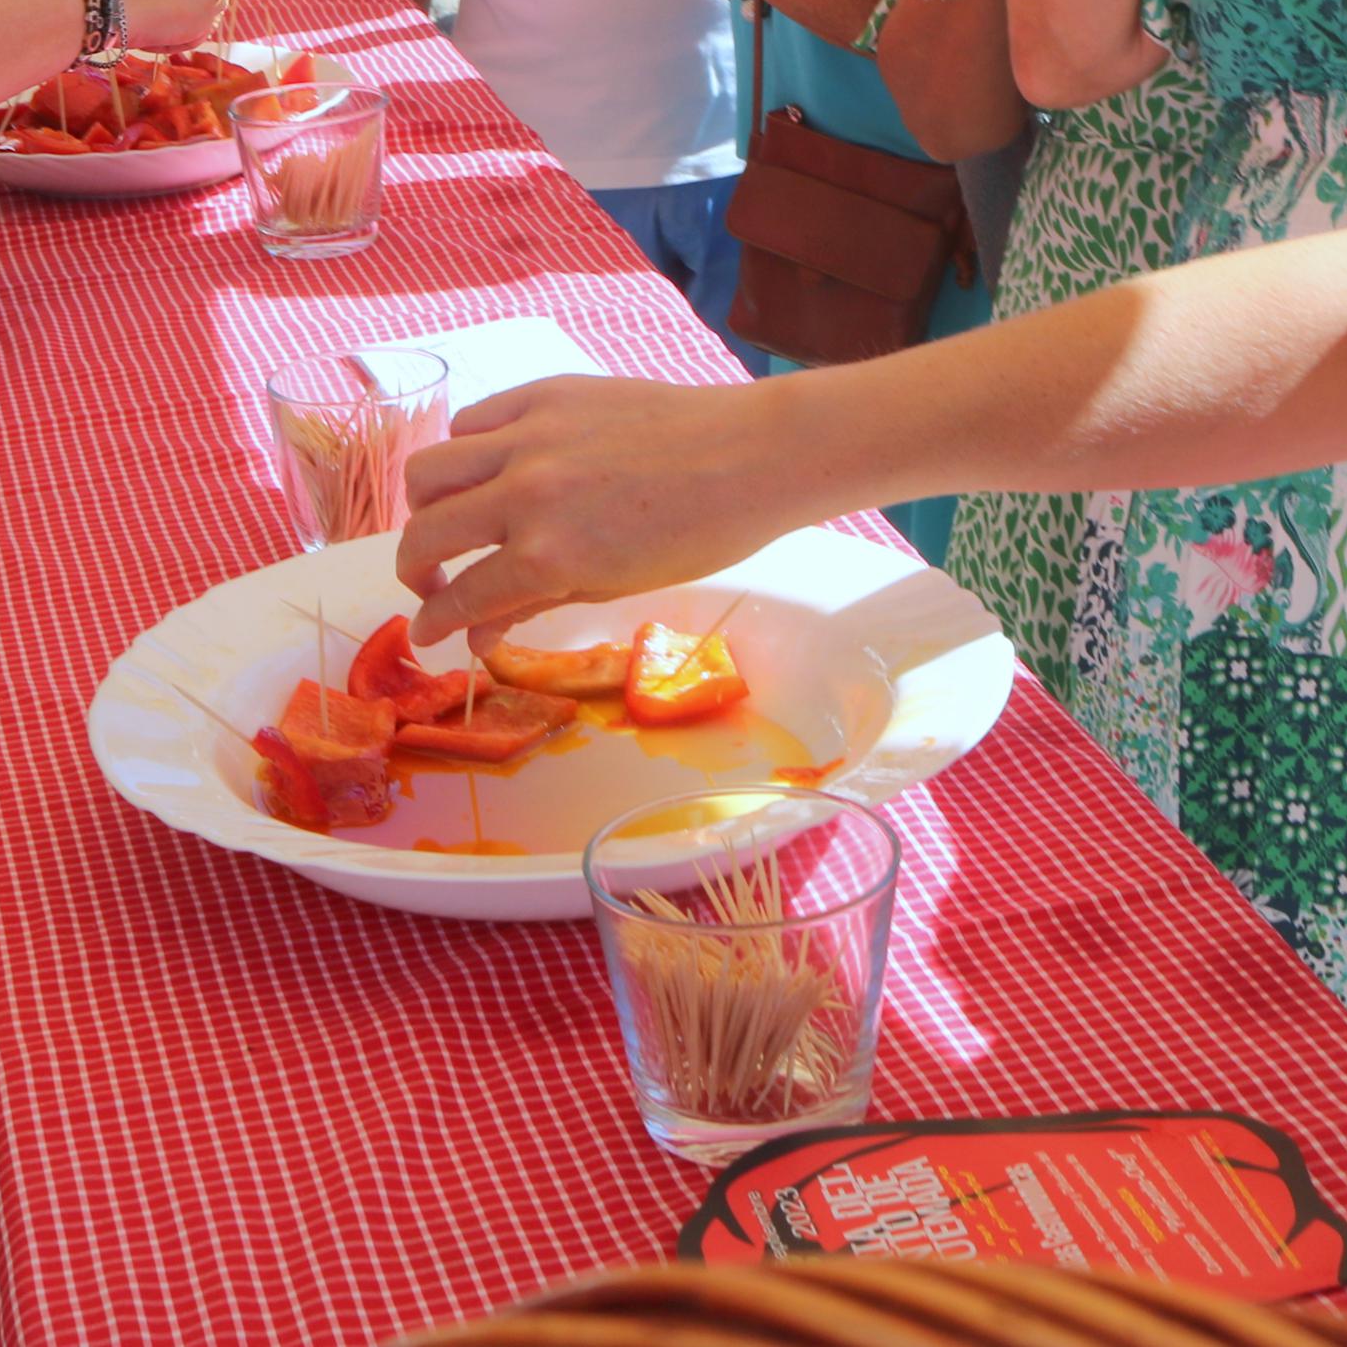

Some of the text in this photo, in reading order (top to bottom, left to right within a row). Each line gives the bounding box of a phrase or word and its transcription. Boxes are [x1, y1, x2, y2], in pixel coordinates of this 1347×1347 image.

[774, 1186, 818, 1239] 2023
[817, 1162, 873, 1220] DEL
[856, 1169, 906, 1208] DE
[892, 1155, 980, 1262] UEMADA
